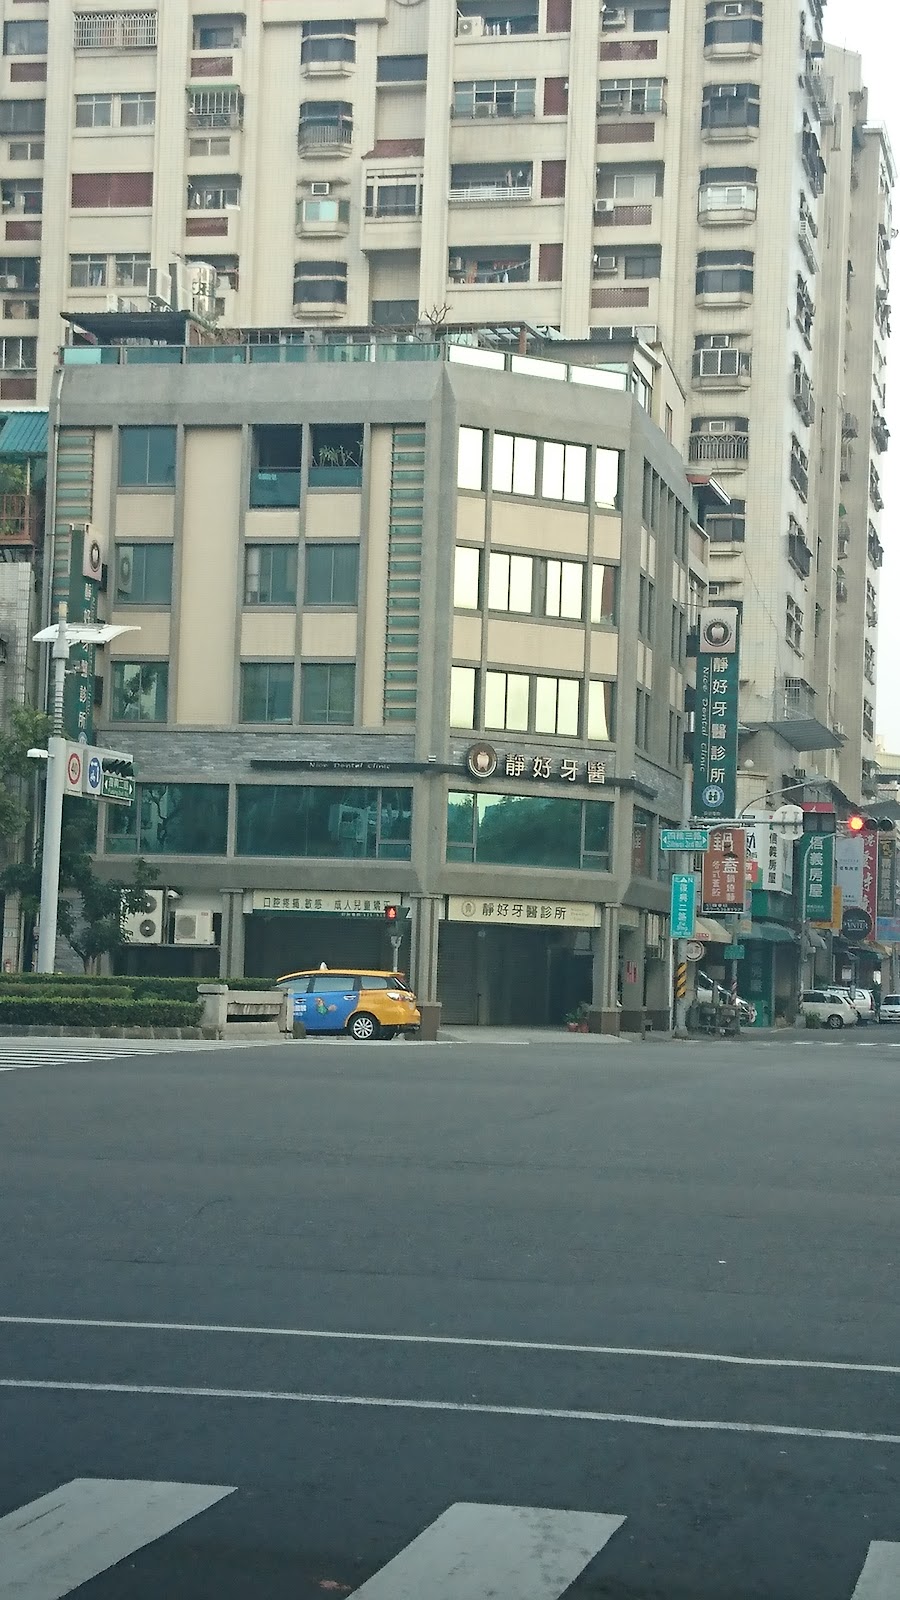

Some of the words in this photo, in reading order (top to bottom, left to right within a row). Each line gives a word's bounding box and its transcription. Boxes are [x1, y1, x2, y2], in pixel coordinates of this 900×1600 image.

[710, 657, 728, 783] 靜好牙醫診所
[505, 753, 606, 784] 靜好牙醫
[809, 836, 823, 897] 信義房屋
[482, 902, 567, 920] 靜好牙醫診所
